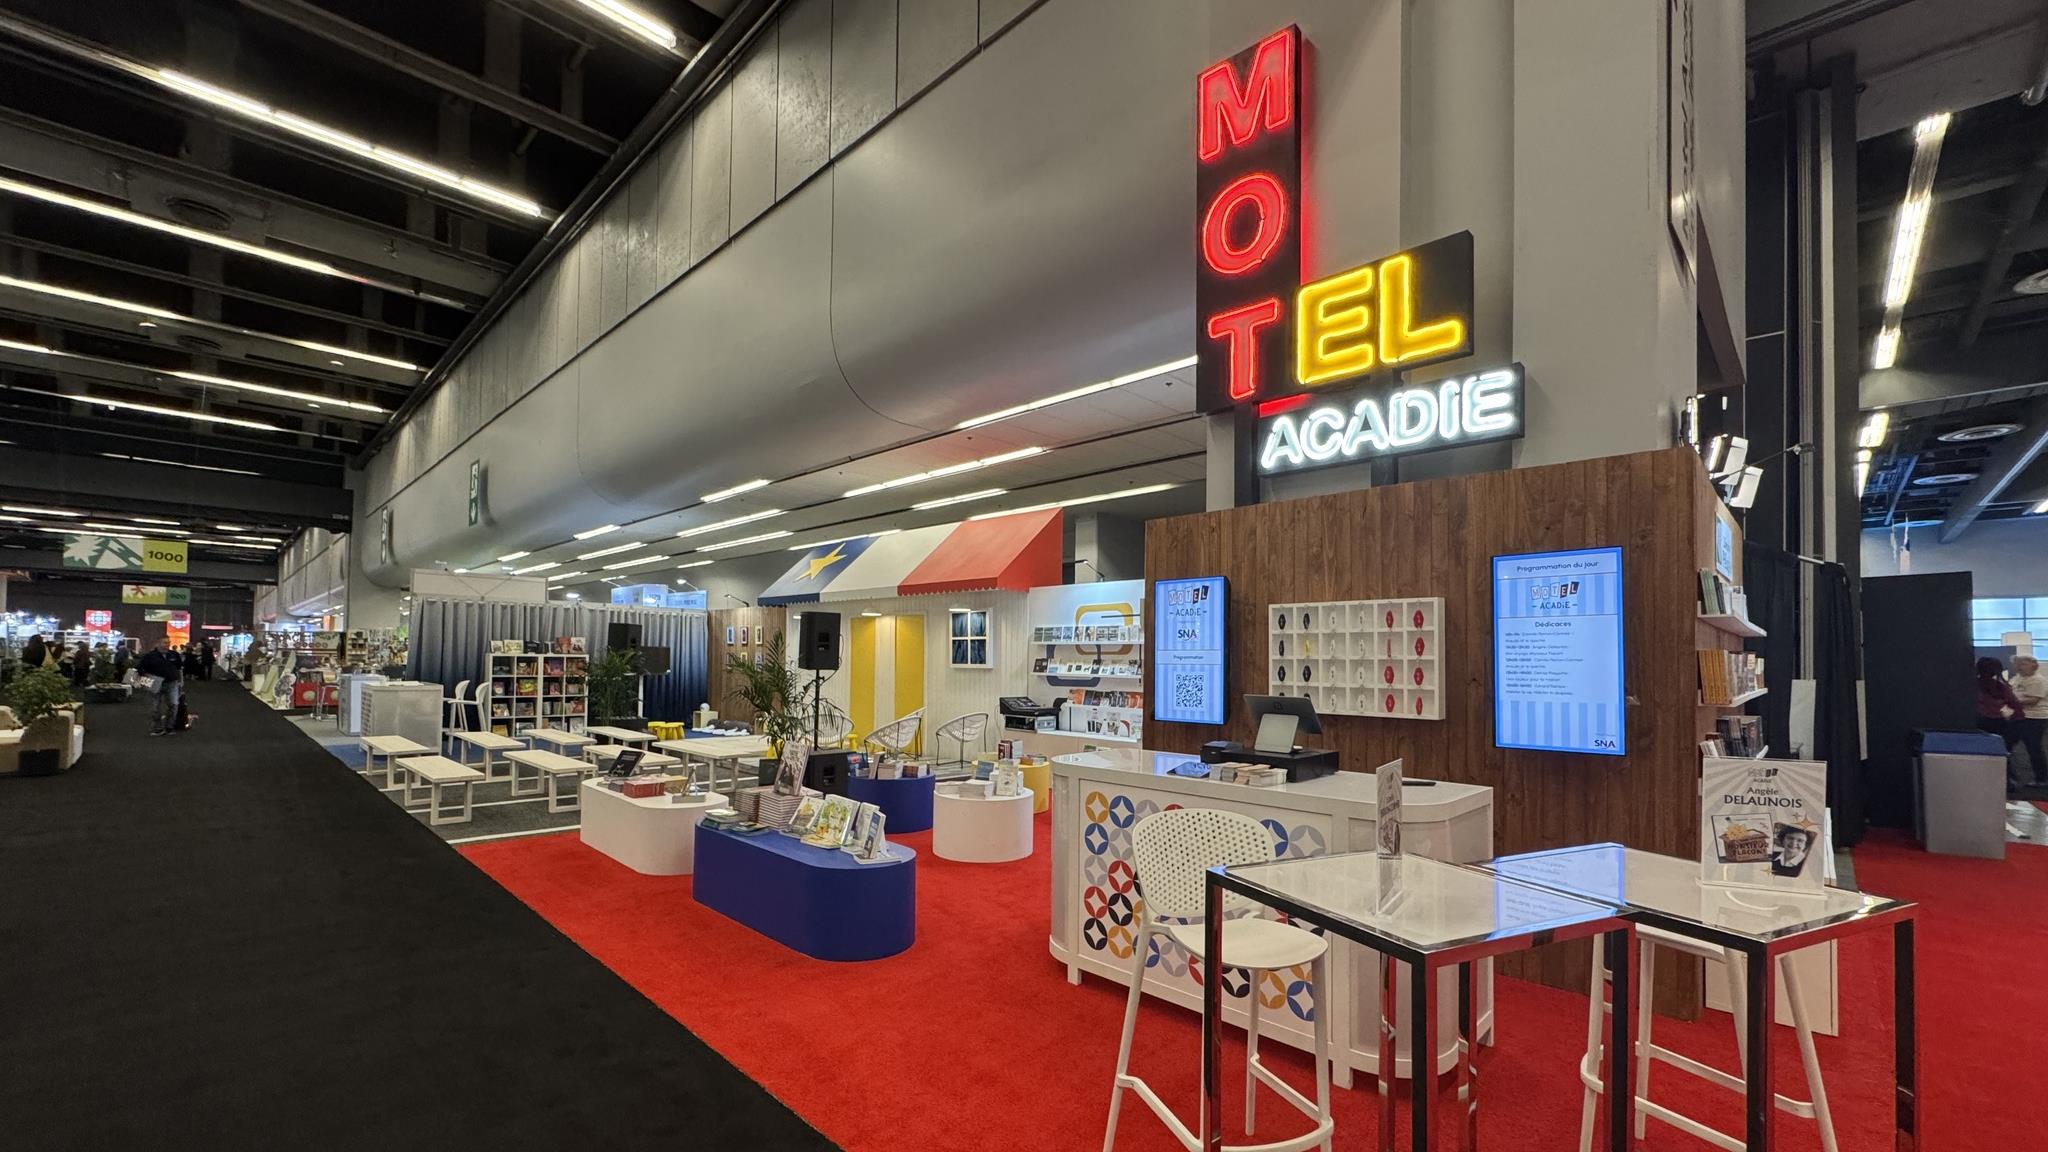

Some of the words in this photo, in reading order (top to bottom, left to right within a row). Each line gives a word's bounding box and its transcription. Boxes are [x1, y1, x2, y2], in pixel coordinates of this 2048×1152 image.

[1261, 371, 1514, 468] ACADIE
[148, 550, 184, 563] 1000
[1516, 563, 1572, 573] Programmation
[1168, 585, 1210, 606] MOTEL
[1530, 581, 1580, 600] MOTEL
[1534, 620, 1572, 628] Dédicaces
[1177, 629, 1198, 640] SNA
[1594, 739, 1616, 749] SNA
[1746, 786, 1779, 797] Angèle
[1724, 794, 1803, 809] DELAUNOIS
